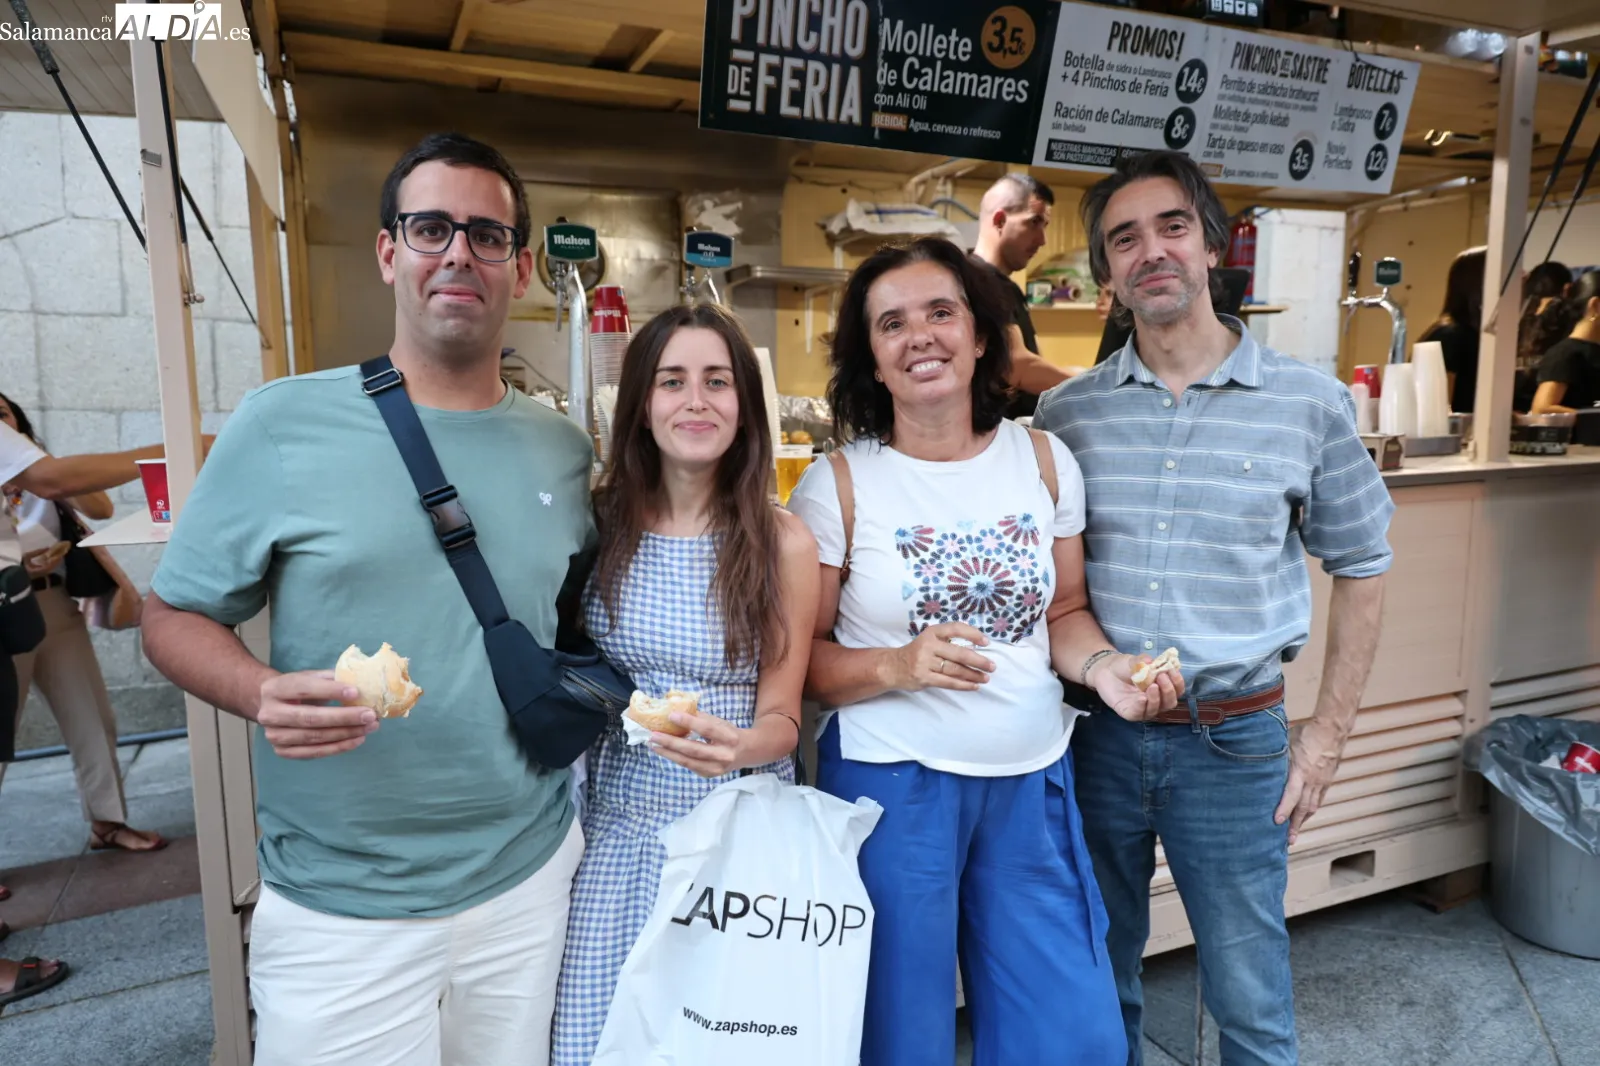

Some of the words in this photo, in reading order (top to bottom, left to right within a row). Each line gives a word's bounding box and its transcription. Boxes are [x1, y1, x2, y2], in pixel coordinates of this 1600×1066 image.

[731, 0, 869, 59] PINCHO
[880, 18, 972, 62] Mollete
[1106, 20, 1185, 62] PROMOS!
[1063, 50, 1105, 72] Botella
[1105, 61, 1115, 71] de
[1115, 62, 1132, 74] sidra
[1133, 66, 1138, 74] o
[1138, 64, 1173, 79] Lambrusco
[1230, 41, 1282, 76] PINCHOS
[1290, 52, 1332, 84] SASTRE
[727, 64, 752, 97] DE
[756, 54, 862, 126] FERIA
[876, 62, 897, 88] de
[901, 56, 1029, 104] Calamares
[1071, 70, 1080, 86] 4
[1082, 70, 1126, 93] Pinchos
[1128, 77, 1142, 94] de
[1144, 77, 1170, 98] Feria
[1178, 66, 1205, 95] 14€
[1246, 79, 1256, 94] de
[1256, 80, 1289, 98] salchicha
[1346, 62, 1401, 96] BOTELLAS
[873, 92, 894, 106] con
[895, 91, 910, 108] Ali
[912, 93, 927, 110] Oli
[1333, 101, 1374, 121] Lambrusco
[909, 118, 931, 133] Agua,
[932, 122, 961, 136] cerveza
[969, 125, 1001, 139] refresco
[1051, 120, 1062, 131] sin
[1063, 121, 1086, 134] bebida
[1053, 100, 1093, 122] Ración
[1094, 106, 1110, 124] de
[1110, 108, 1166, 131] Calamares
[1170, 114, 1190, 140] 8€
[1337, 117, 1356, 134] Sidra
[1053, 151, 1065, 161] SON
[1206, 132, 1227, 150] Tarta
[1227, 135, 1236, 151] de
[1236, 140, 1259, 156] queso
[1269, 142, 1285, 155] vaso
[553, 234, 591, 246] Mahou
[683, 1006, 798, 1037] www.zapshop.es
